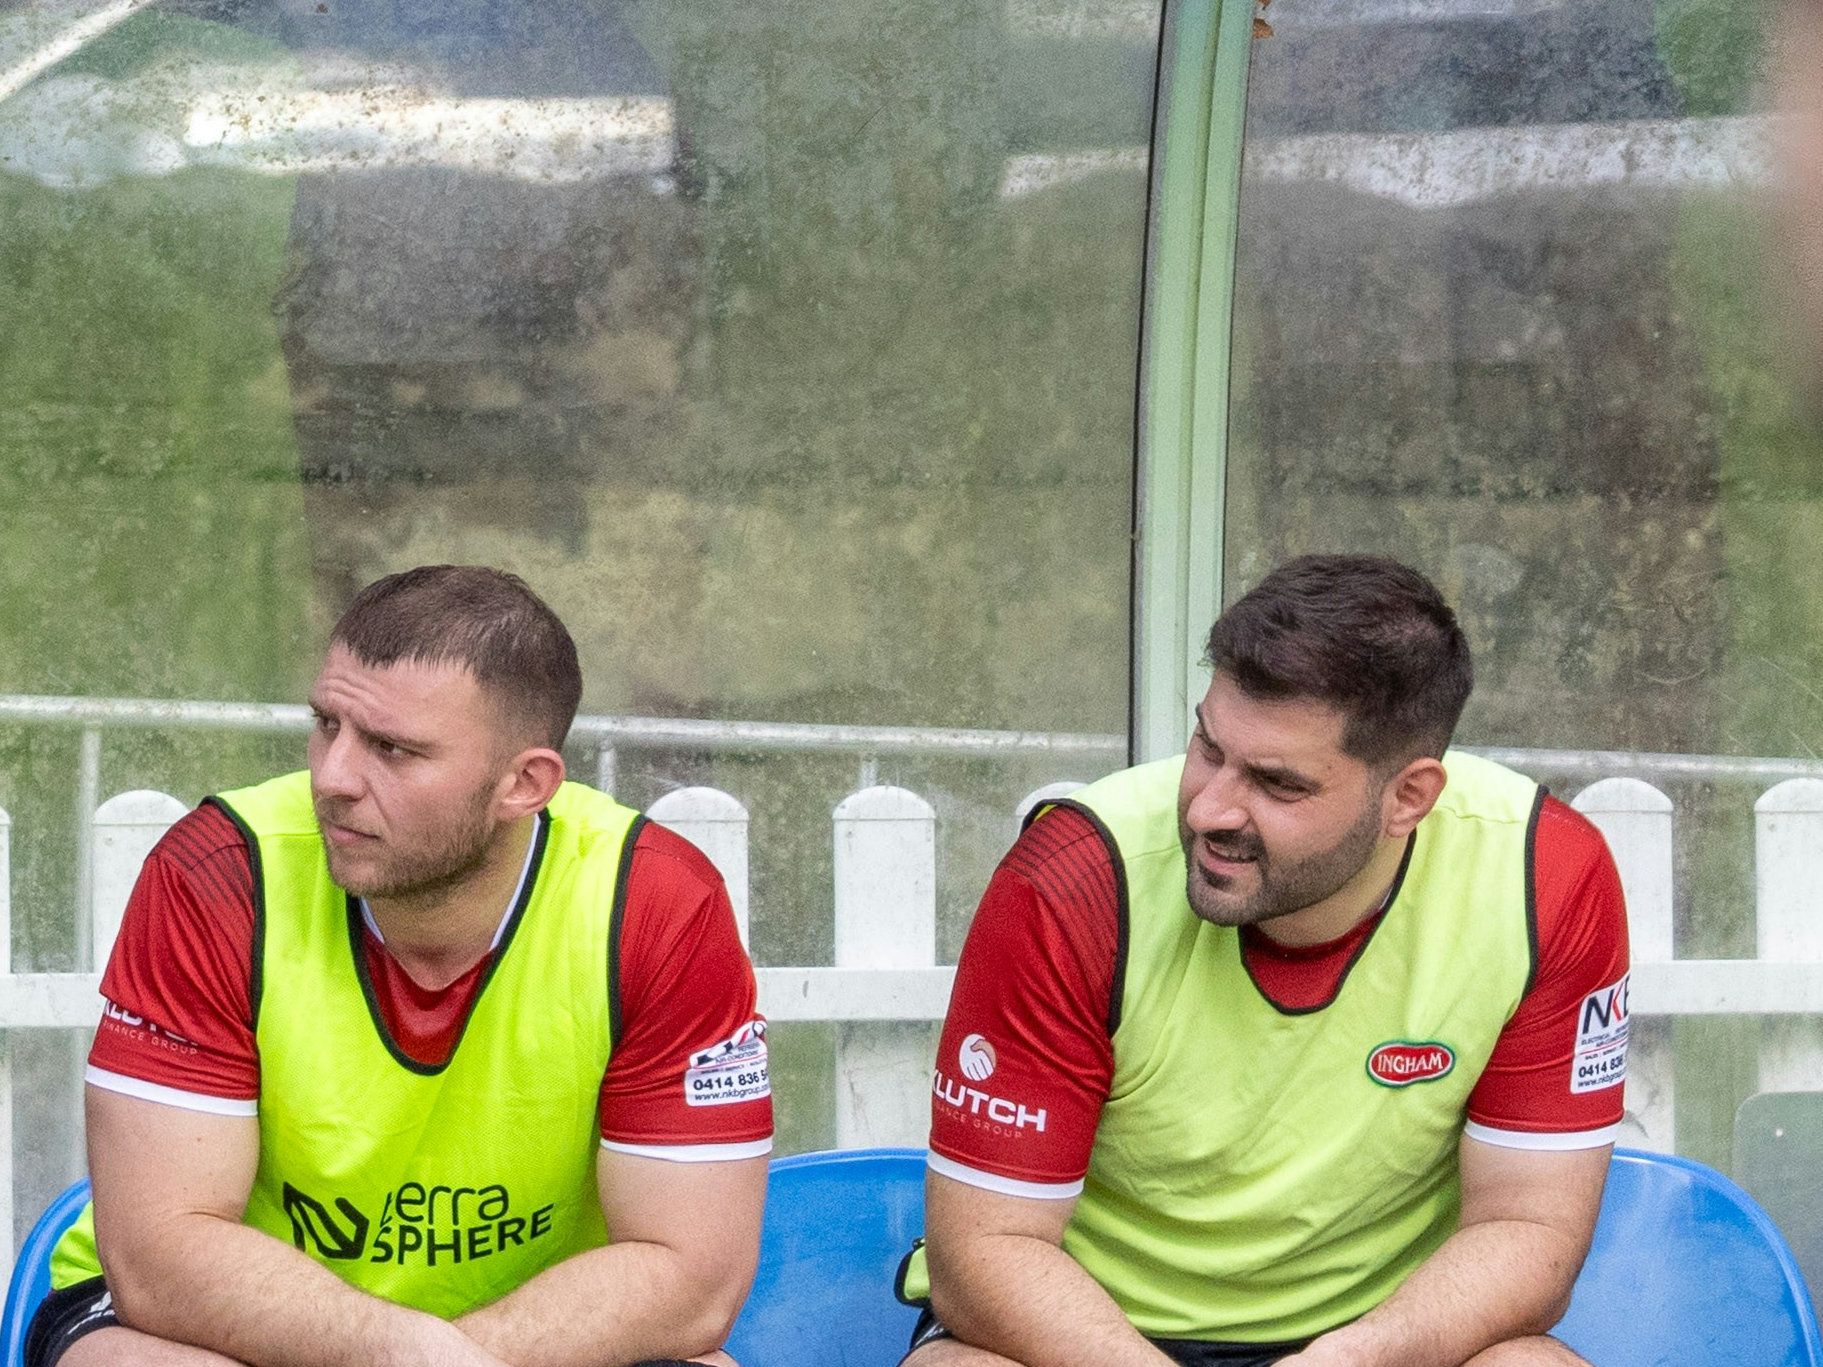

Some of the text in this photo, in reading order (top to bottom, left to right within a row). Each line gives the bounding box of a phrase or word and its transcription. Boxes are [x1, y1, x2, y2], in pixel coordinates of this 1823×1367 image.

[151, 1036, 198, 1055] GROUP
[1377, 1051, 1444, 1075] INGHAM
[1578, 1060, 1608, 1078] 0414
[693, 1076, 734, 1091] 0414
[738, 1071, 760, 1086] 836
[973, 1118, 1023, 1139] GROUP
[370, 1202, 555, 1267] SPHERE
